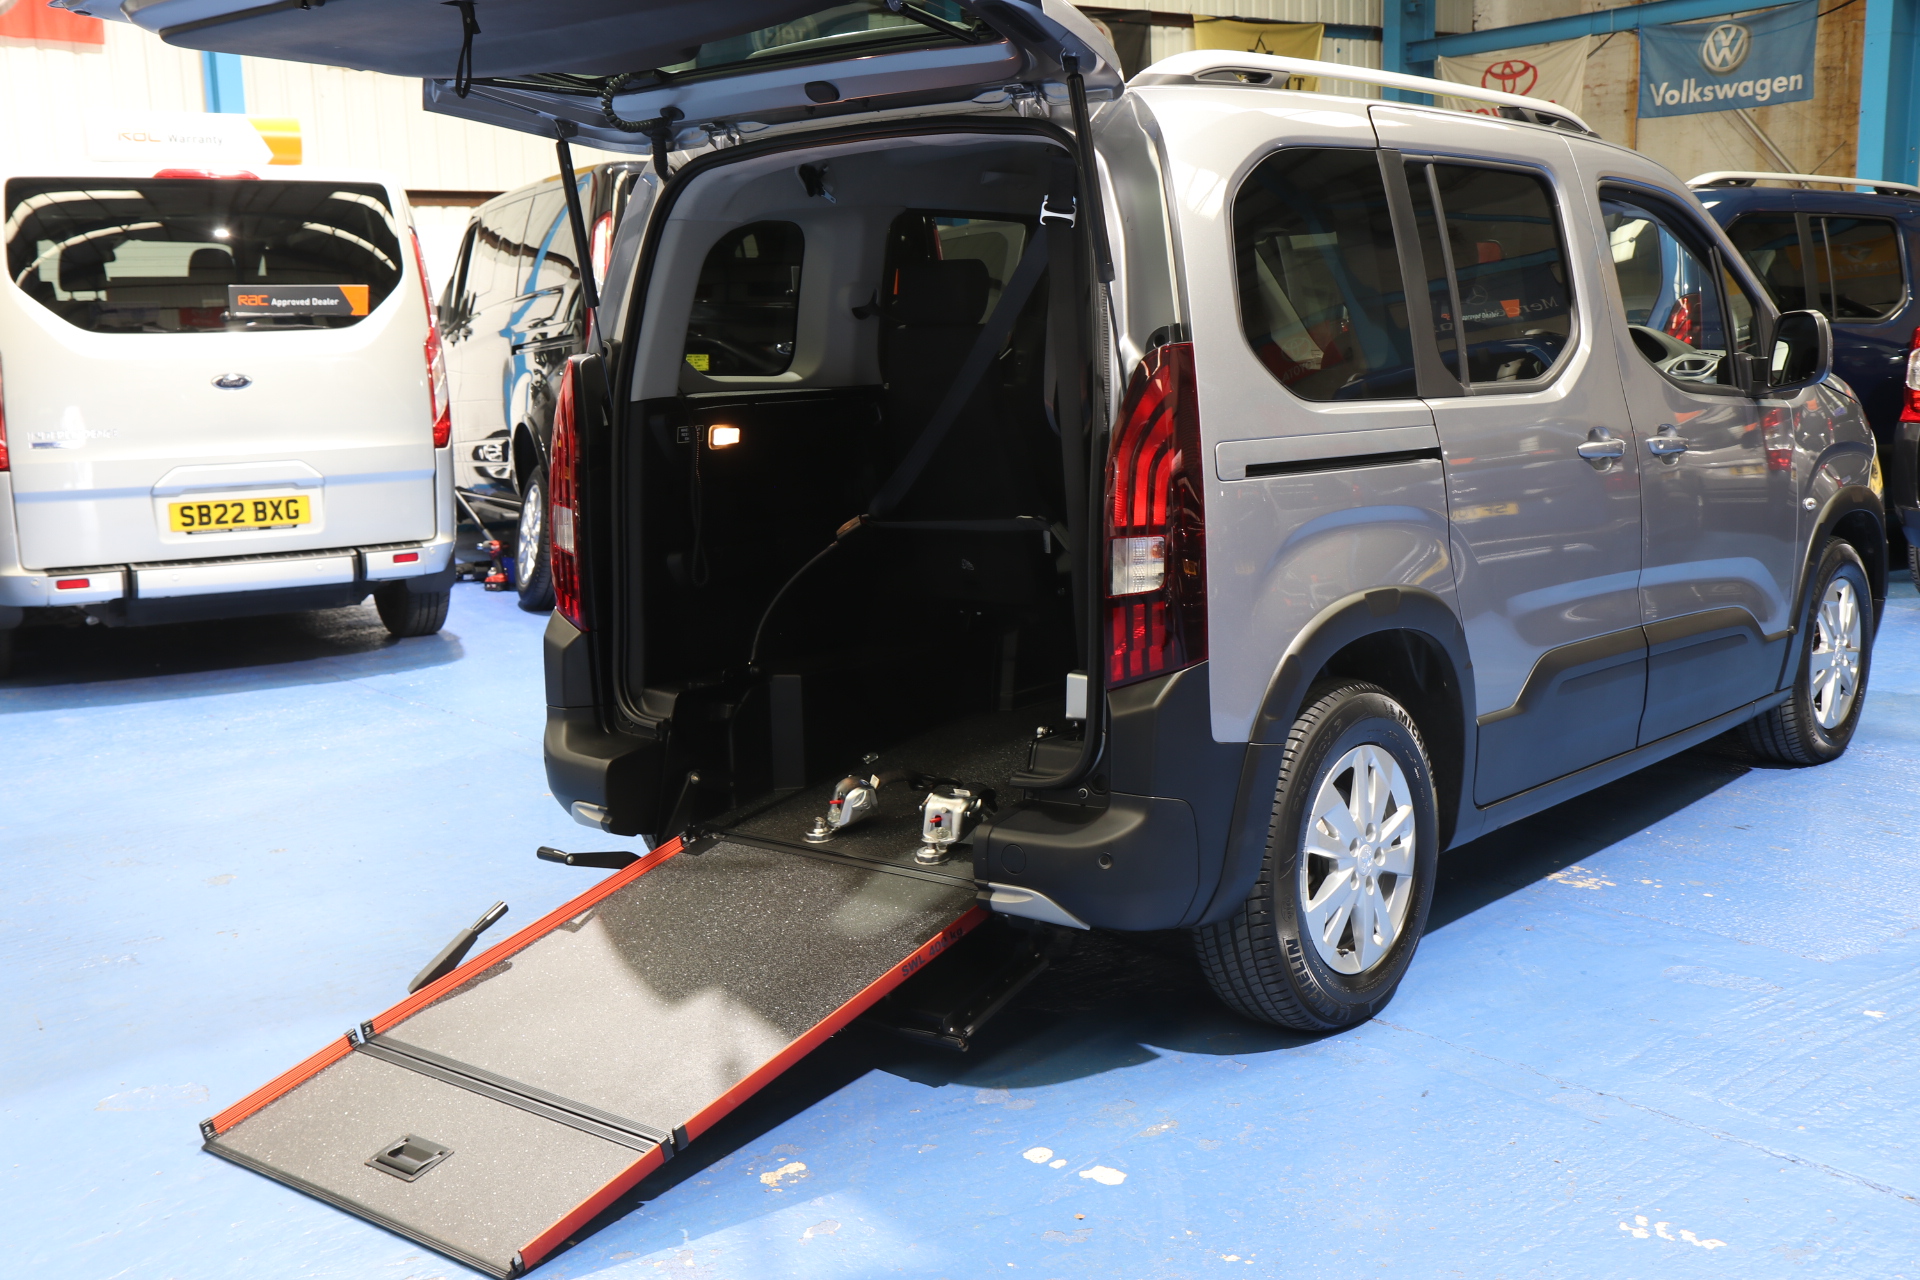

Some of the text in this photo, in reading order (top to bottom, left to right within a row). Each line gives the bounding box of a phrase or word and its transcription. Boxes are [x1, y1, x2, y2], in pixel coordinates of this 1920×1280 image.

[1650, 73, 1803, 107] Volkswagen
[168, 134, 223, 145] Warranty
[237, 294, 340, 307] RAC Approved Dealer
[27, 429, 118, 440] INDEPEDENCE
[180, 499, 300, 527] SB22 BXG
[901, 955, 926, 977] SWL
[929, 937, 949, 956] 400
